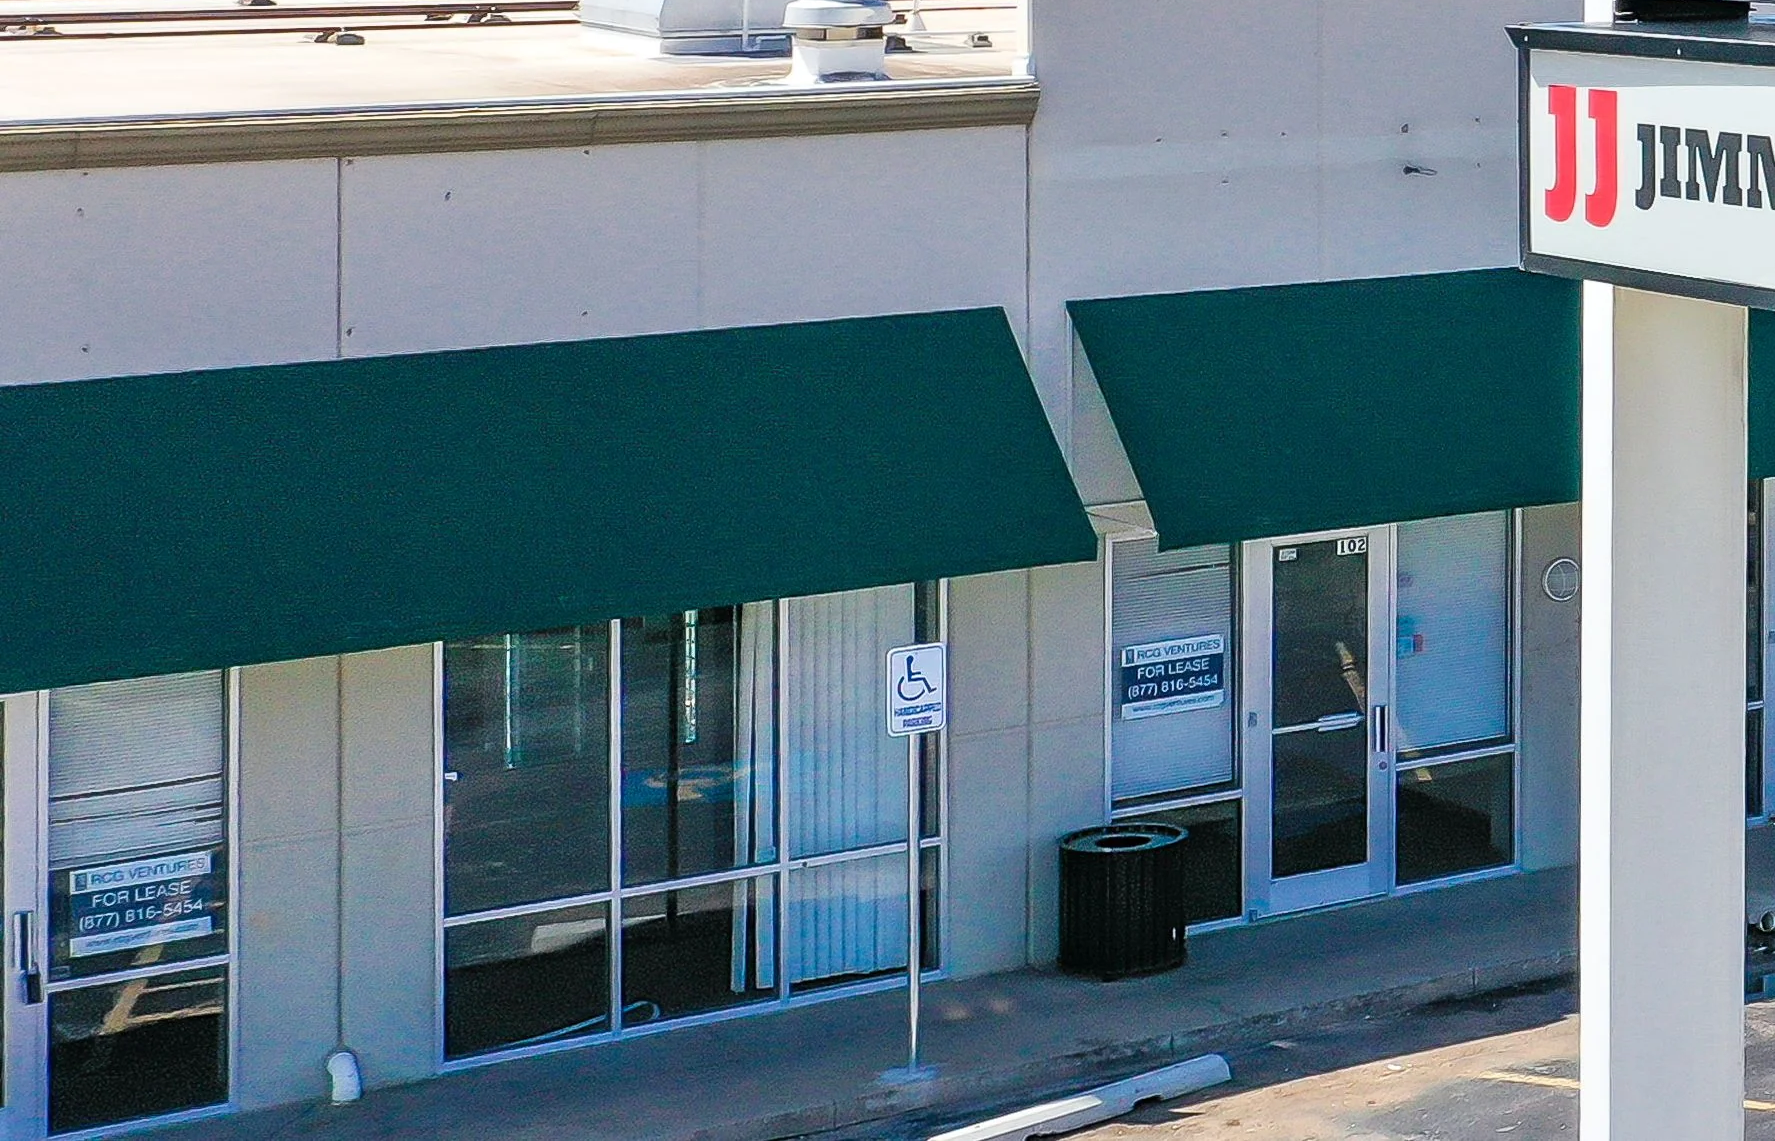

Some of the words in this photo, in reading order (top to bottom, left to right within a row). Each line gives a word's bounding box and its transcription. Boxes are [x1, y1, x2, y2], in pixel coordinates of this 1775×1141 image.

[1545, 85, 1618, 227] JJ
[1340, 539, 1365, 554] 102
[1163, 639, 1220, 656] VENTURES
[1137, 665, 1165, 680] FOR
[1168, 657, 1210, 675] LEASE
[1128, 683, 1158, 699] (877)
[1161, 674, 1218, 692] 816-5454
[129, 857, 206, 880] VENTURES
[92, 890, 130, 908] FOR
[135, 879, 192, 902] LEASE
[78, 912, 120, 932] (877)
